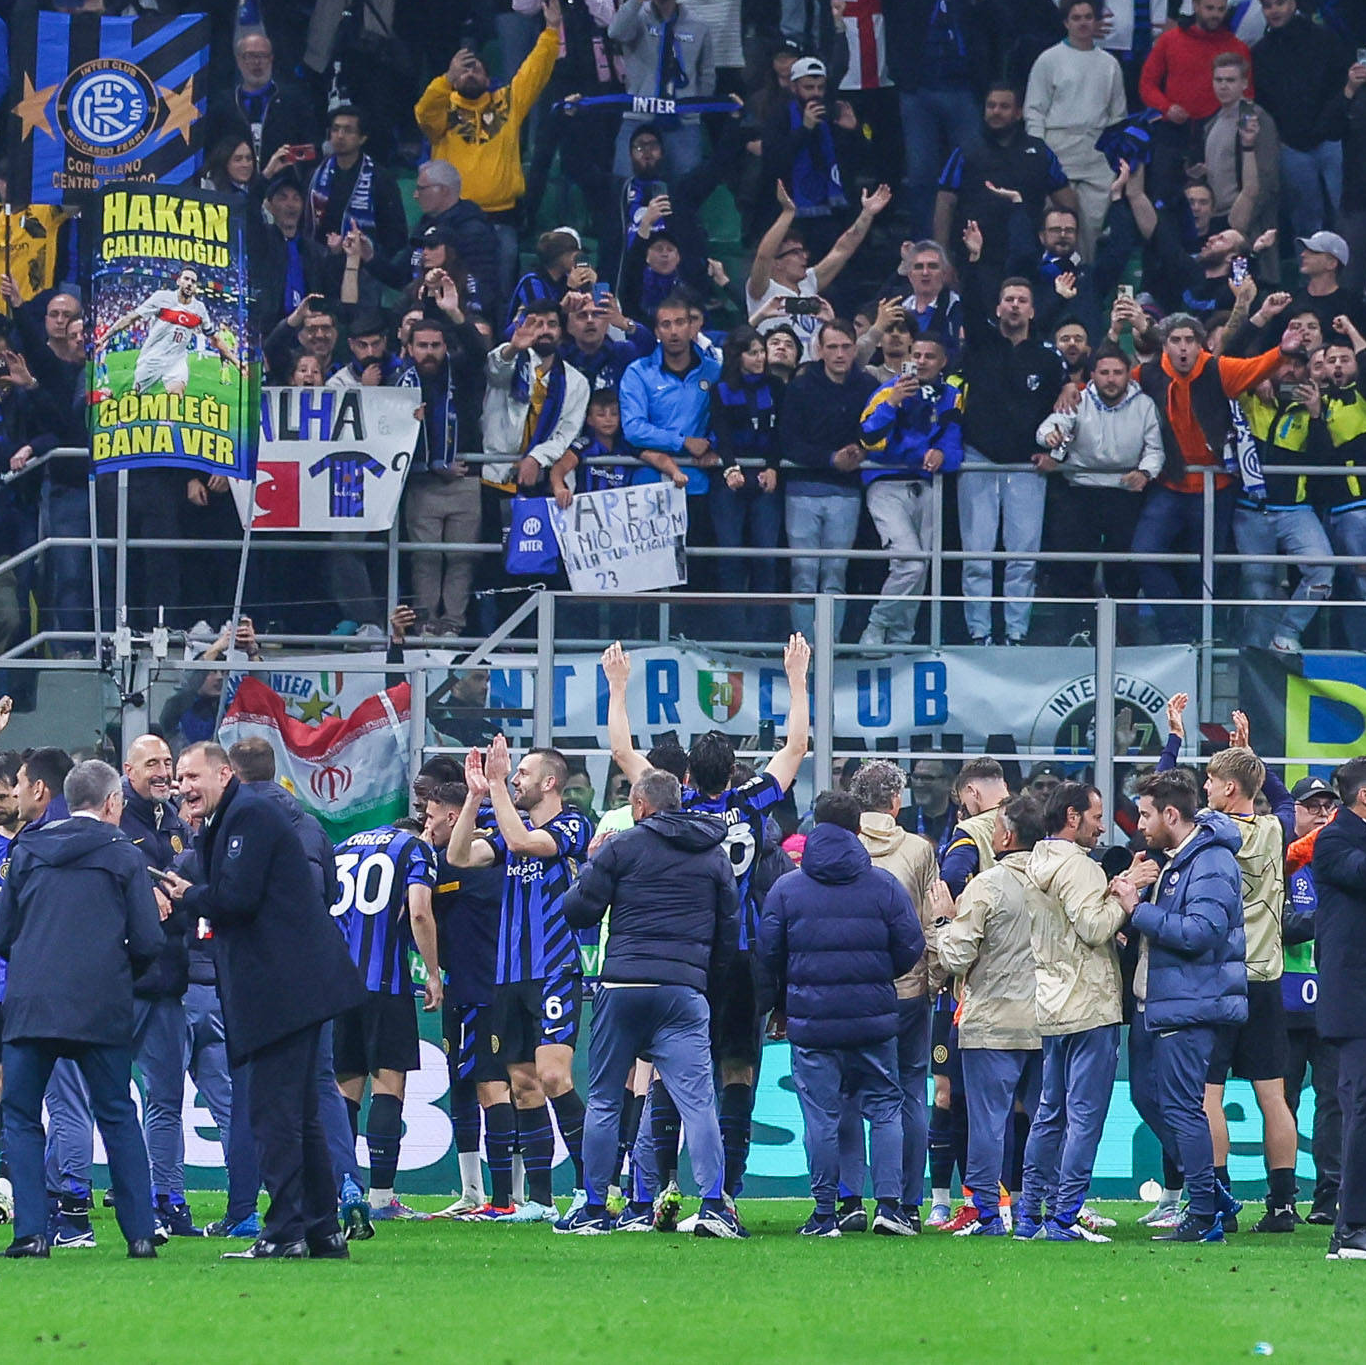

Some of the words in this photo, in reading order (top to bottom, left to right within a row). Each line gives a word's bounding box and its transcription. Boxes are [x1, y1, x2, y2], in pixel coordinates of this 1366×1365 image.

[631, 95, 676, 114] INTER
[52, 171, 101, 190] CENTRO
[66, 159, 142, 177] CORIGLIANO
[103, 190, 229, 243] HAKAN
[102, 234, 229, 269] ÇALHANOĞLU
[93, 425, 175, 462] BANA
[179, 427, 235, 467] VER
[519, 539, 543, 553] INTER
[595, 570, 619, 589] 23
[758, 660, 949, 728] CUB
[1048, 677, 1098, 718] INTE
[346, 833, 395, 847] CARLOS
[329, 851, 396, 918] 30
[546, 995, 564, 1020] 6
